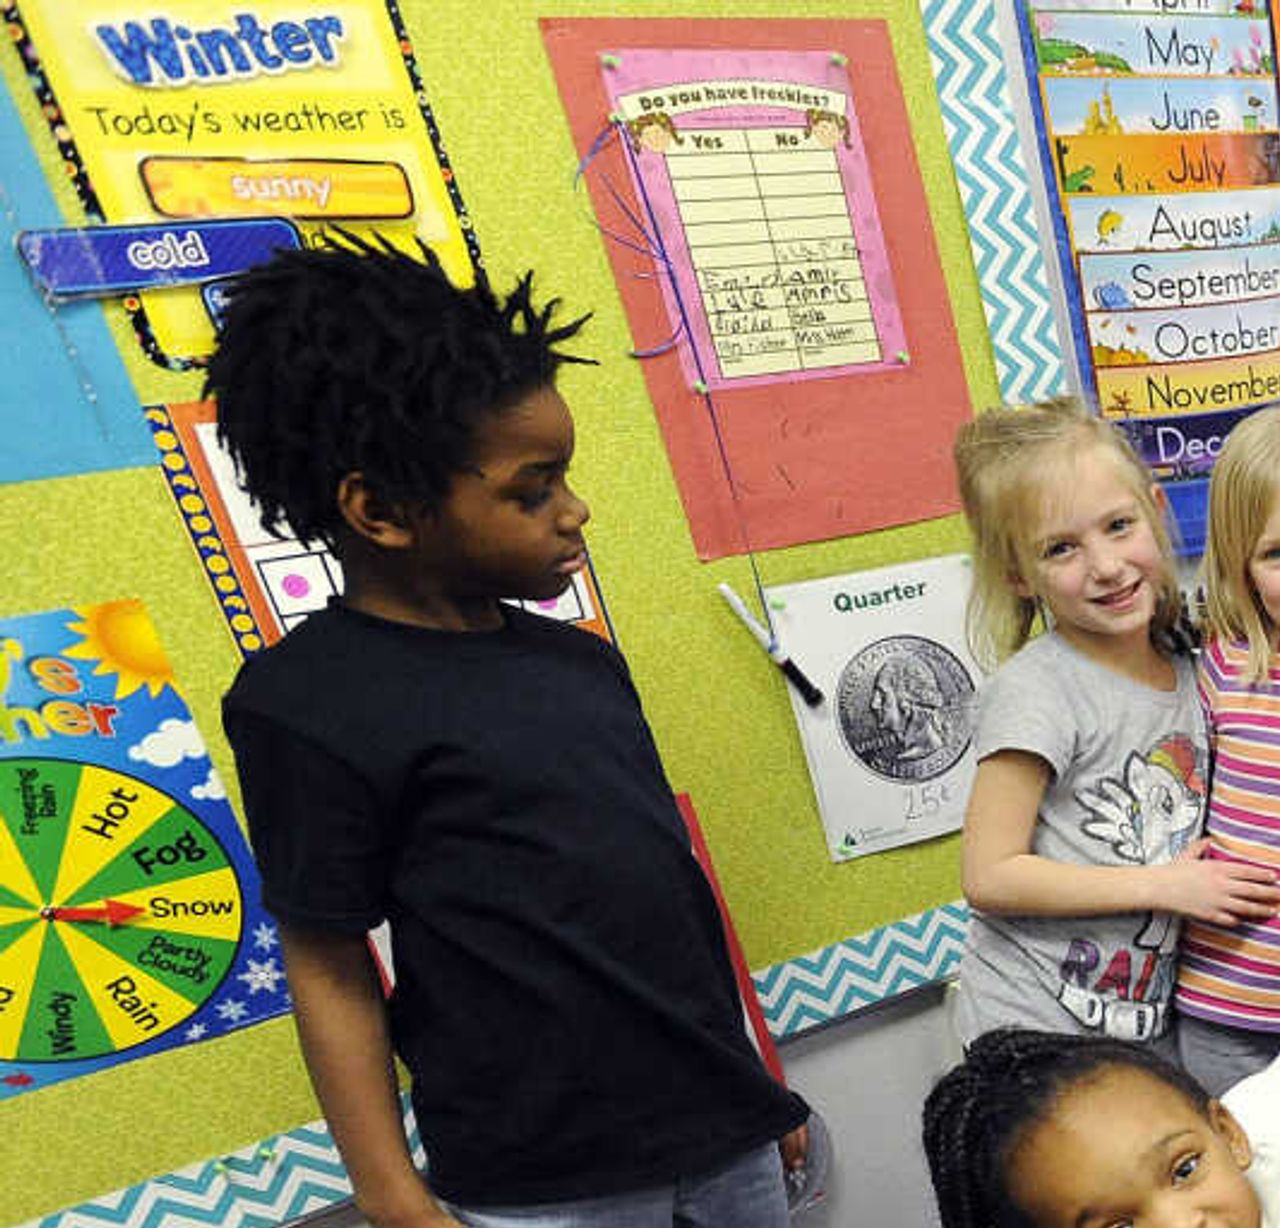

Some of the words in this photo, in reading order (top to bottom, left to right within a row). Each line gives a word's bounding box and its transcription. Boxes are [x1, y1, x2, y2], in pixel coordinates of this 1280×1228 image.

[96, 13, 344, 84] Winter
[1144, 25, 1216, 73] May
[639, 95, 665, 112] Do
[668, 88, 702, 107] you
[702, 86, 748, 102] have
[1150, 91, 1222, 132] June
[87, 104, 222, 142] Today's
[236, 106, 369, 132] weather
[381, 104, 406, 130] is
[691, 134, 724, 149] Yes
[774, 133, 799, 147] No
[1167, 143, 1227, 188] July
[232, 174, 332, 206] sunny
[1149, 203, 1253, 249] August
[128, 231, 209, 270] cold
[1131, 256, 1280, 307] September
[1154, 311, 1279, 359] October
[833, 581, 927, 613] Quarter
[81, 786, 139, 839] Hot
[134, 830, 208, 877] Fog
[149, 896, 234, 919] Snow
[136, 951, 211, 985] Cloudy
[149, 935, 213, 965] Partly
[46, 990, 78, 1056] Windy
[105, 975, 162, 1032] Rain
